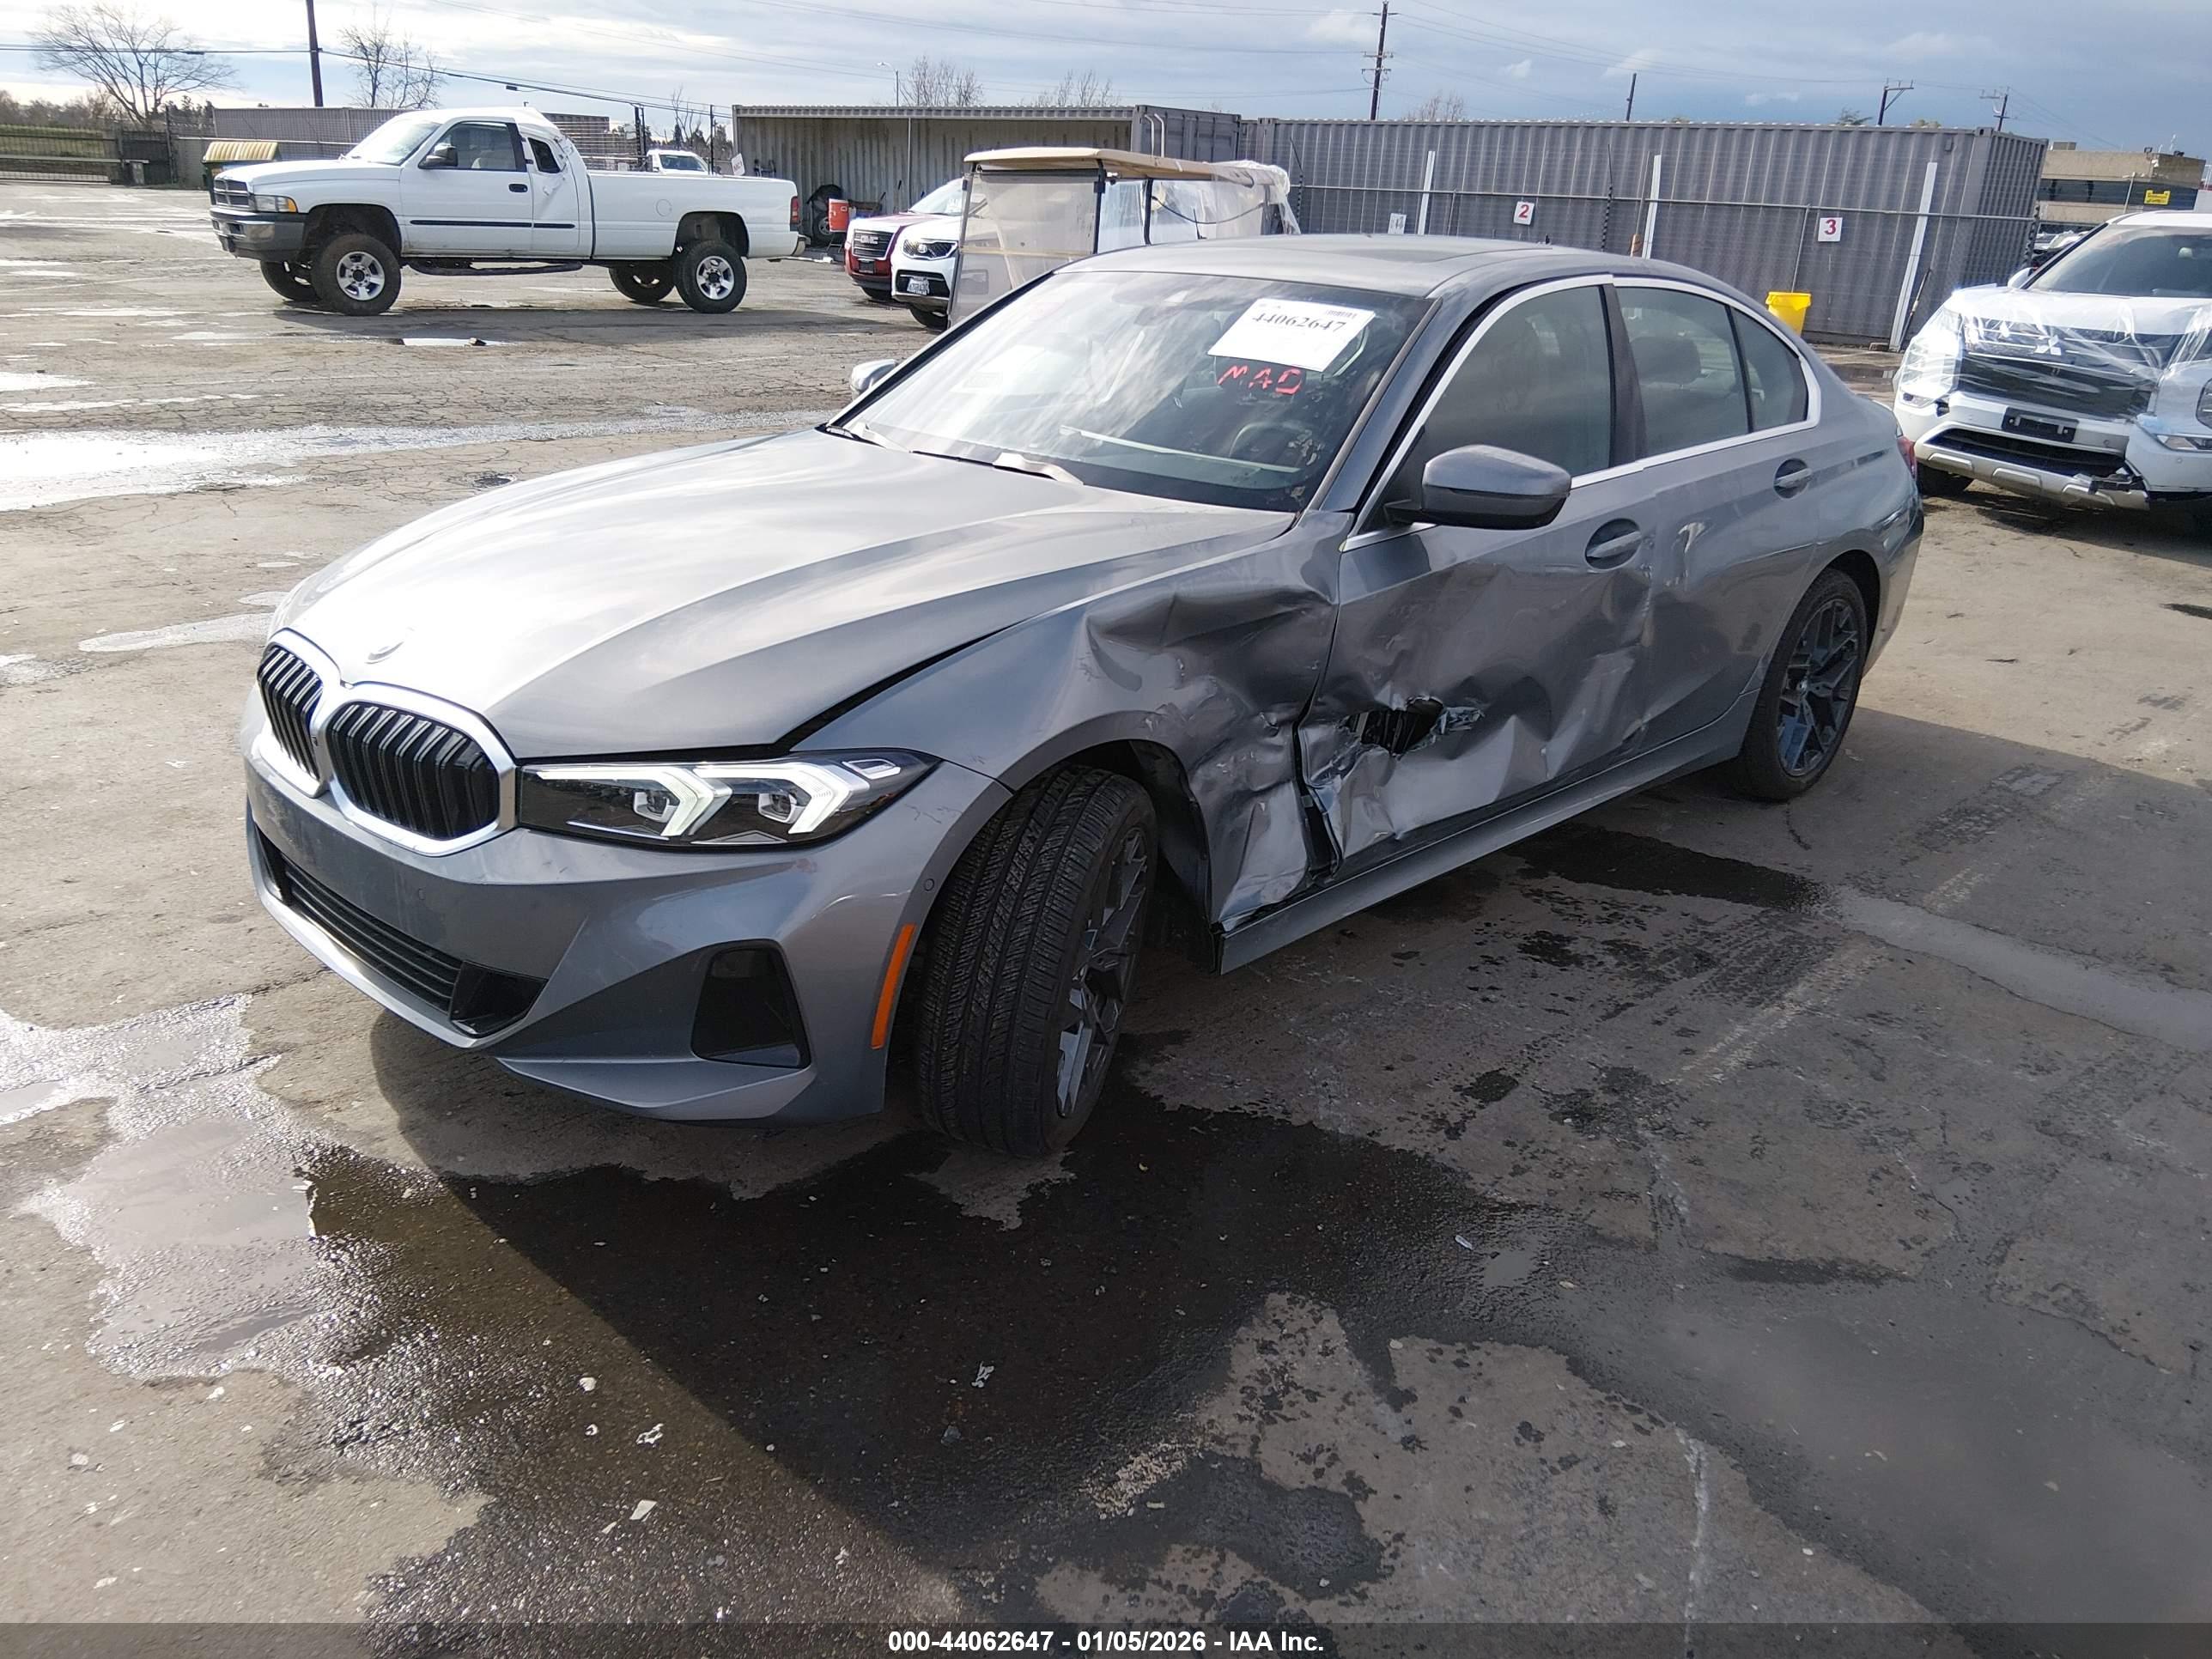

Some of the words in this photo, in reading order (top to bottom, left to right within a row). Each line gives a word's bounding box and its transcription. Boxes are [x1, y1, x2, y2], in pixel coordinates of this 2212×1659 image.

[1518, 204, 1529, 218] 2
[1825, 219, 1836, 235] 3
[1252, 313, 1346, 332] 44062647
